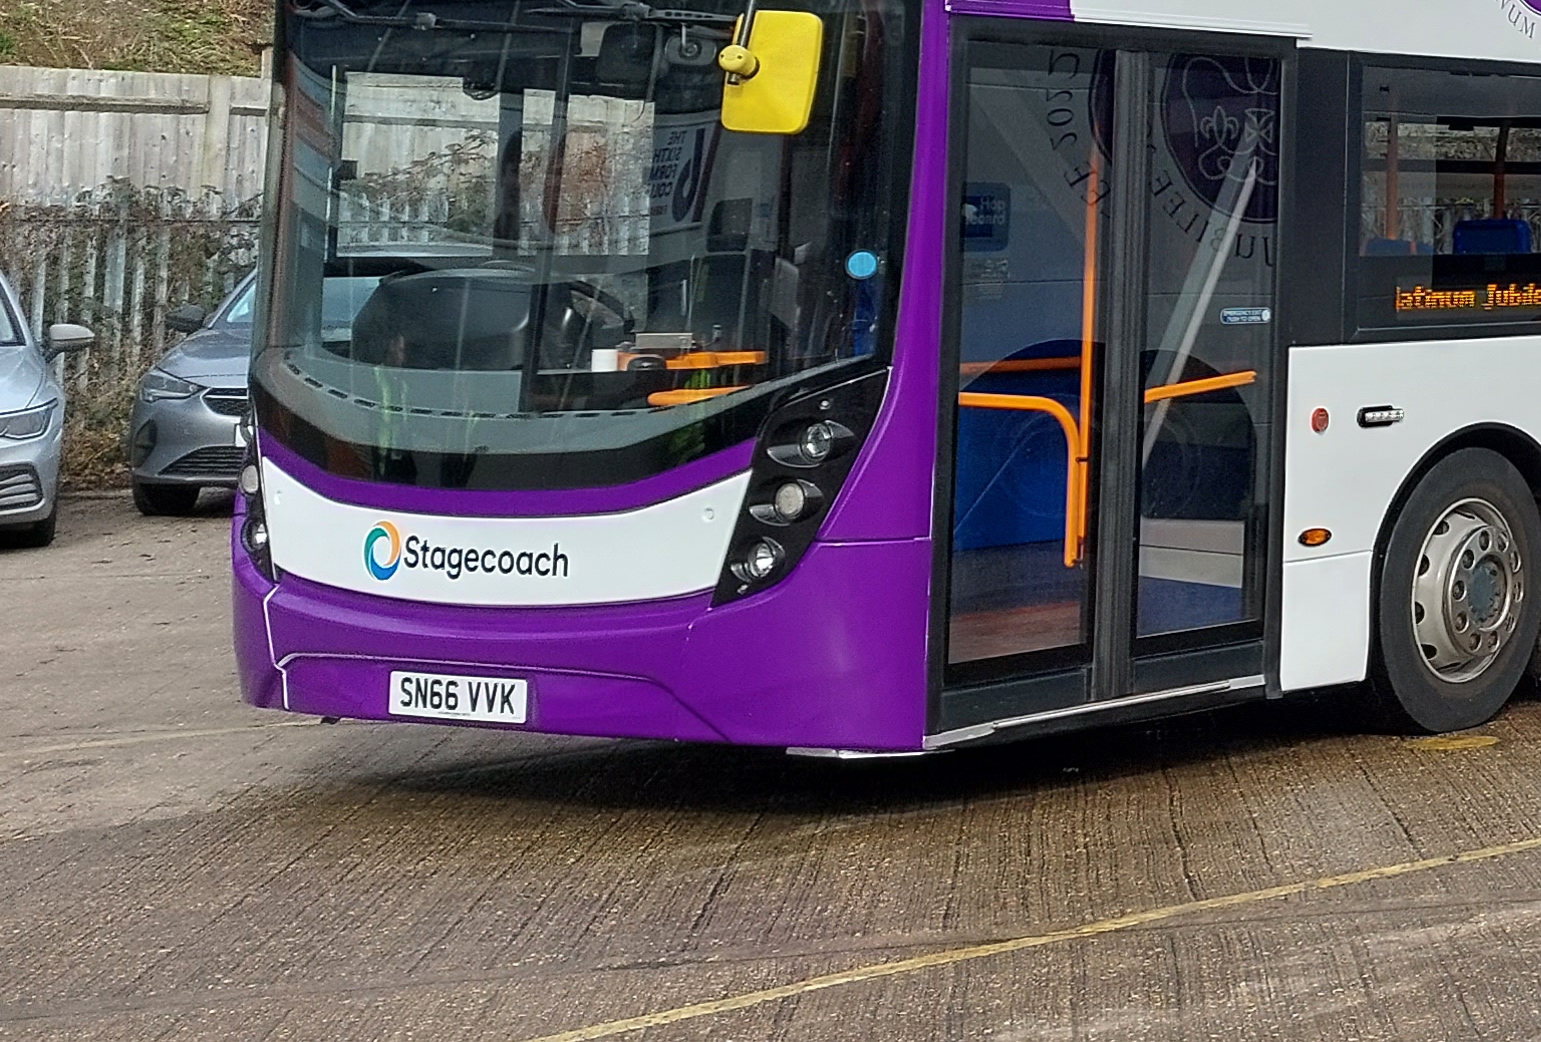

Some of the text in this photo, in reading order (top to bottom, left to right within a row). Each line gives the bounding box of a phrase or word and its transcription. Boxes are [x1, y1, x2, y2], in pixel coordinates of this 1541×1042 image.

[403, 535, 569, 580] Stagecoach
[400, 676, 516, 715] SN66 VVK
